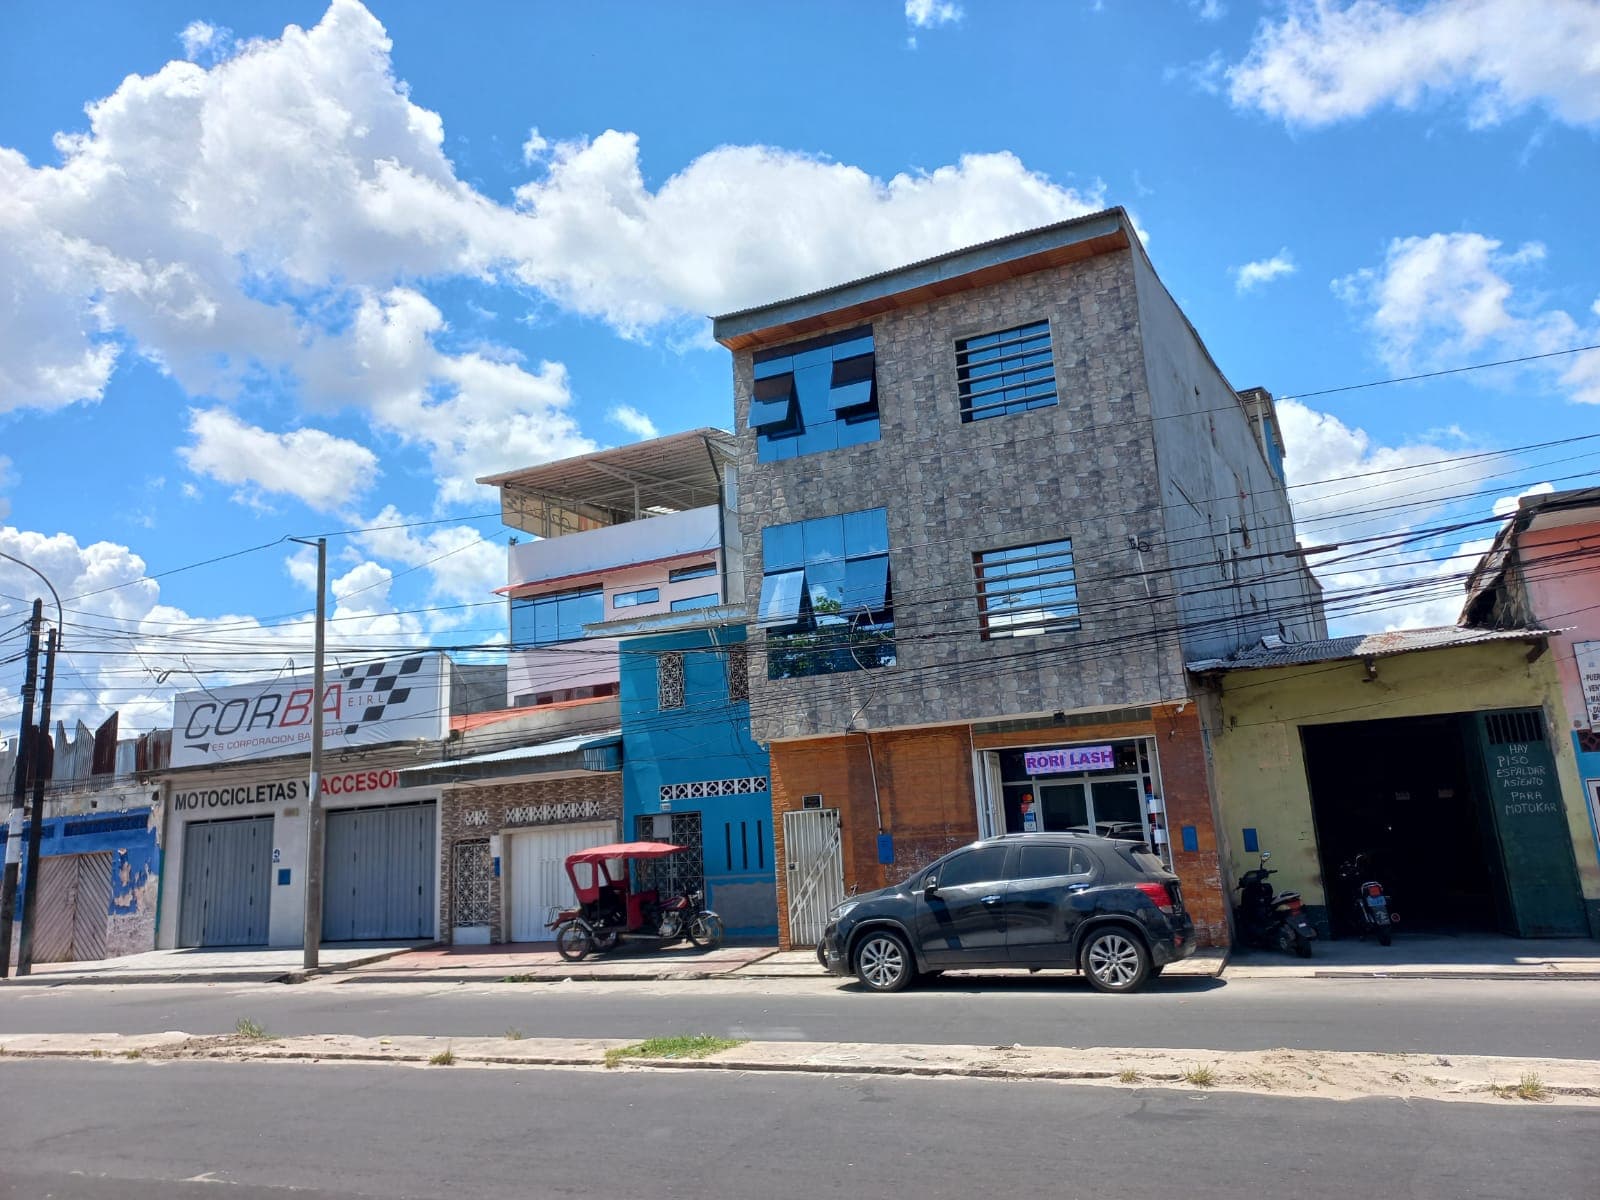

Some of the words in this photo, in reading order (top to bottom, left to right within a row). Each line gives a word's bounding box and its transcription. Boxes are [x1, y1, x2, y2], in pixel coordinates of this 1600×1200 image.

[185, 683, 342, 739] CORBA
[227, 733, 295, 750] CORPORACION
[1509, 744, 1528, 754] HAY
[1026, 754, 1065, 769] RORI
[1069, 750, 1114, 765] LASH
[1497, 755, 1529, 767] PISO
[1503, 776, 1544, 788] ASIENTO
[174, 780, 297, 811] MOTOCICLETAS
[301, 778, 312, 796] Y
[1511, 791, 1543, 802] PARA
[1505, 802, 1558, 816] MOTOKAR
